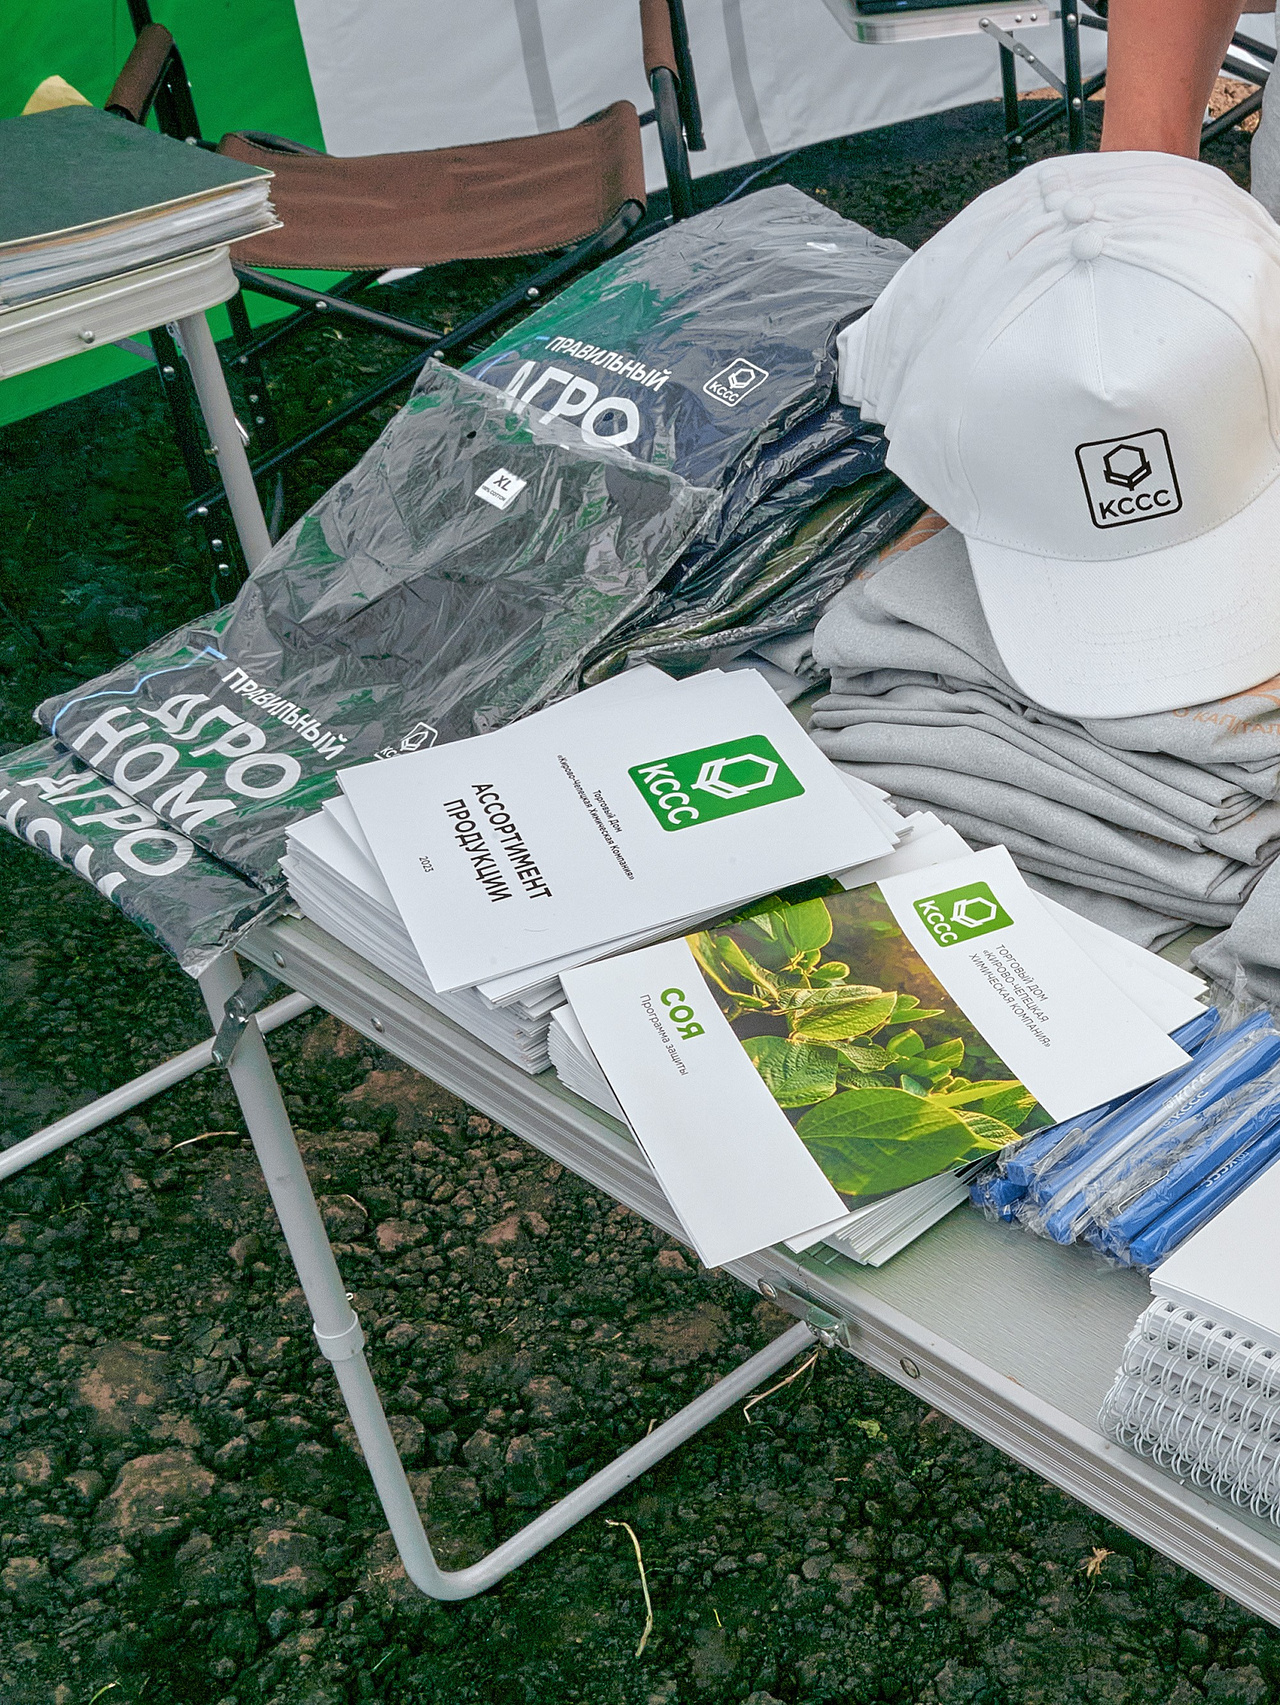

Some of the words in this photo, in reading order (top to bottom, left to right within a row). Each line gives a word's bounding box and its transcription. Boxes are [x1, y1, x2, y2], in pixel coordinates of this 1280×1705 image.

[545, 336, 672, 392] ПРАВИЛЬНЫЙ
[493, 475, 512, 491] XL
[137, 693, 301, 799] АГРО
[222, 666, 348, 761] ПРАВИЛЬНЫЙ
[471, 783, 553, 899] АССОРТИМЕНТ
[588, 807, 615, 846] Химическая
[609, 844, 635, 881] Компания»
[592, 789, 616, 820] Торговый
[608, 817, 623, 834] Дом
[419, 856, 434, 873] 2023
[443, 798, 513, 903] ПРОДУКЦИИ
[968, 953, 1015, 1004] ХИМИЧЕСКАЯ
[1010, 1001, 1051, 1049] КОМПАНИЯ»
[982, 949, 1049, 1024] «КИРОВО-ЧЕПЕЦКАЯ
[996, 943, 1035, 987] ТОРГОВЫЙ
[1027, 982, 1049, 1003] ДОМ
[640, 994, 671, 1044] Программа
[665, 1043, 689, 1076] защиты
[660, 987, 706, 1041] СОЯ
